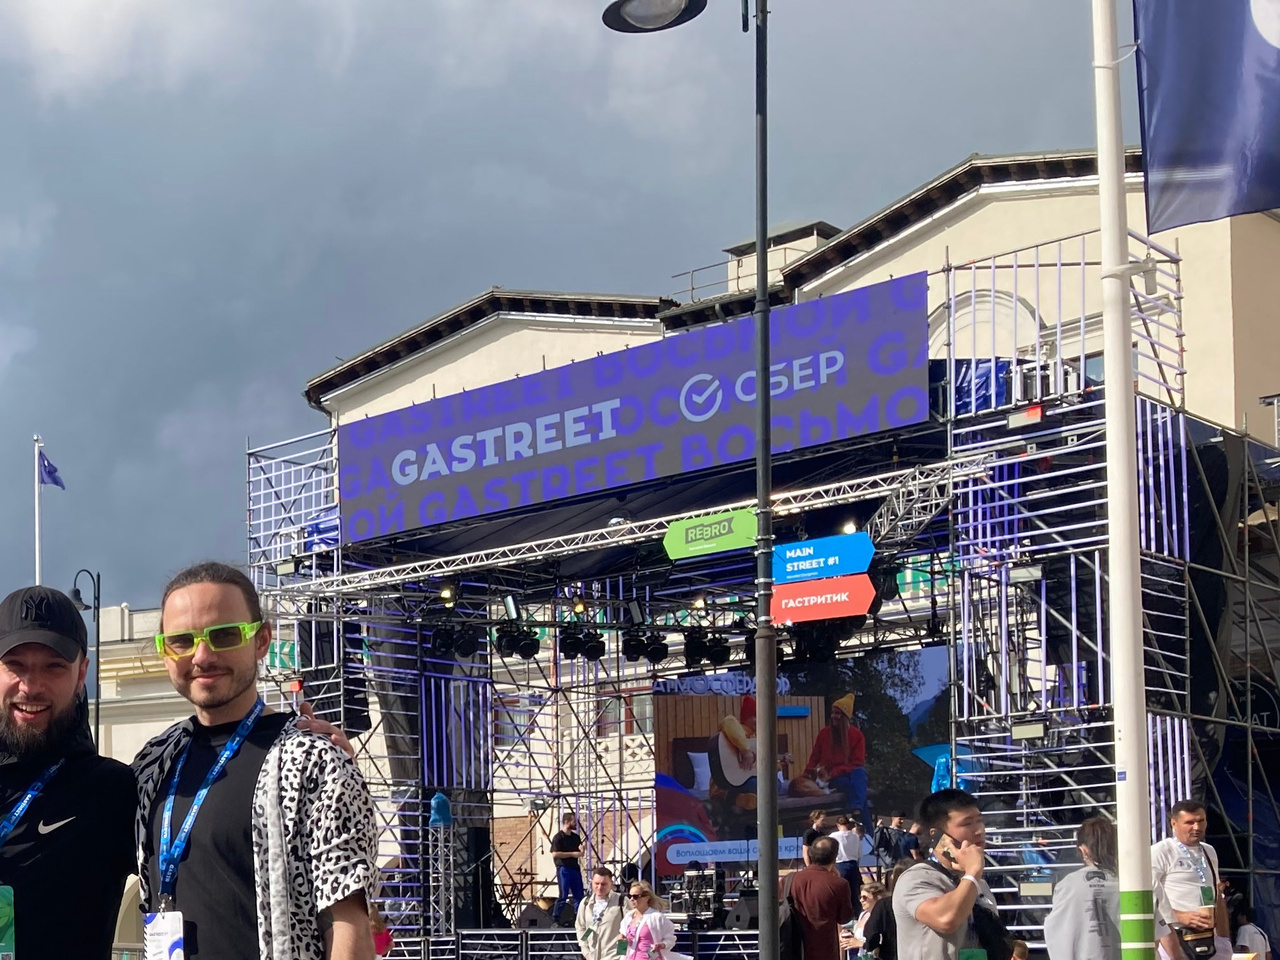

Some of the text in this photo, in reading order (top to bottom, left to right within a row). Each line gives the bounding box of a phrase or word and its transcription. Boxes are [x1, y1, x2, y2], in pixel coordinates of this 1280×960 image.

[391, 398, 621, 486] GASTREET
[688, 521, 729, 541] REBRO
[786, 546, 814, 559] MAIN
[786, 555, 840, 572] STREET #1
[781, 591, 850, 609] ГАСТРИТИК
